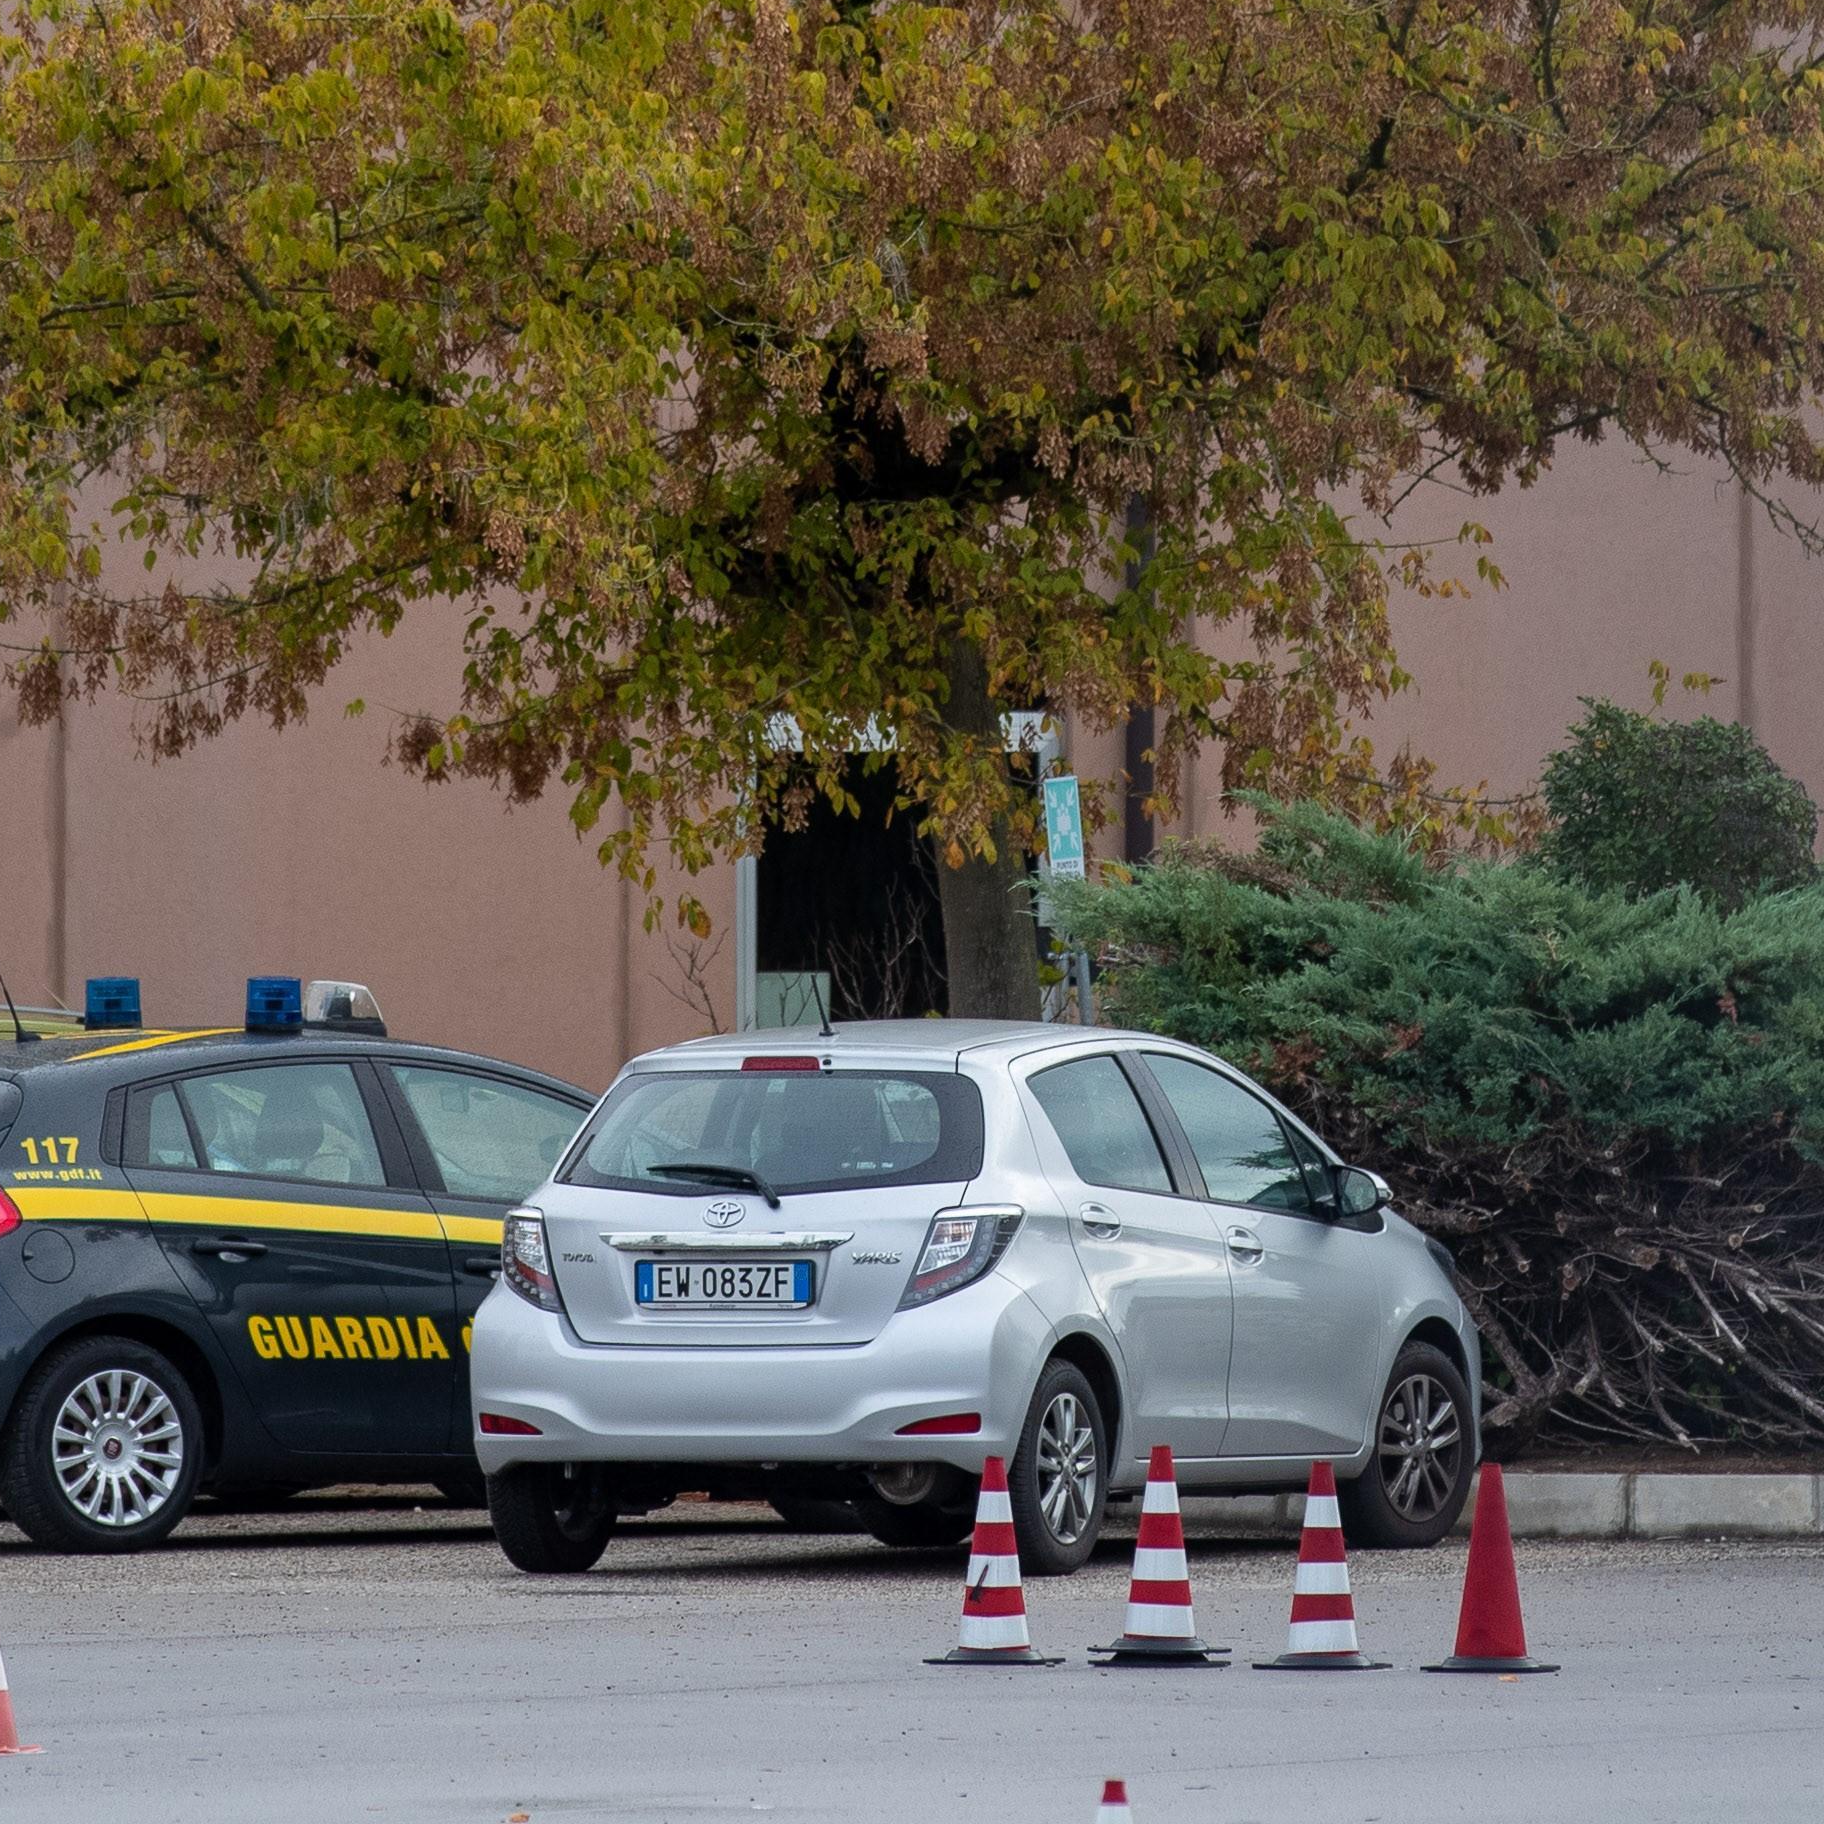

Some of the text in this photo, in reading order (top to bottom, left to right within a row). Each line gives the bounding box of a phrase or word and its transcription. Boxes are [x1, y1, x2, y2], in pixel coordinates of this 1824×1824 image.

[20, 1137, 80, 1164] 117
[13, 1168, 103, 1182] www.gdf.it
[851, 1251, 903, 1266] YARIS
[658, 1267, 691, 1298] EW
[702, 1267, 790, 1298] 083ZF
[247, 1316, 451, 1360] GUARDIA
